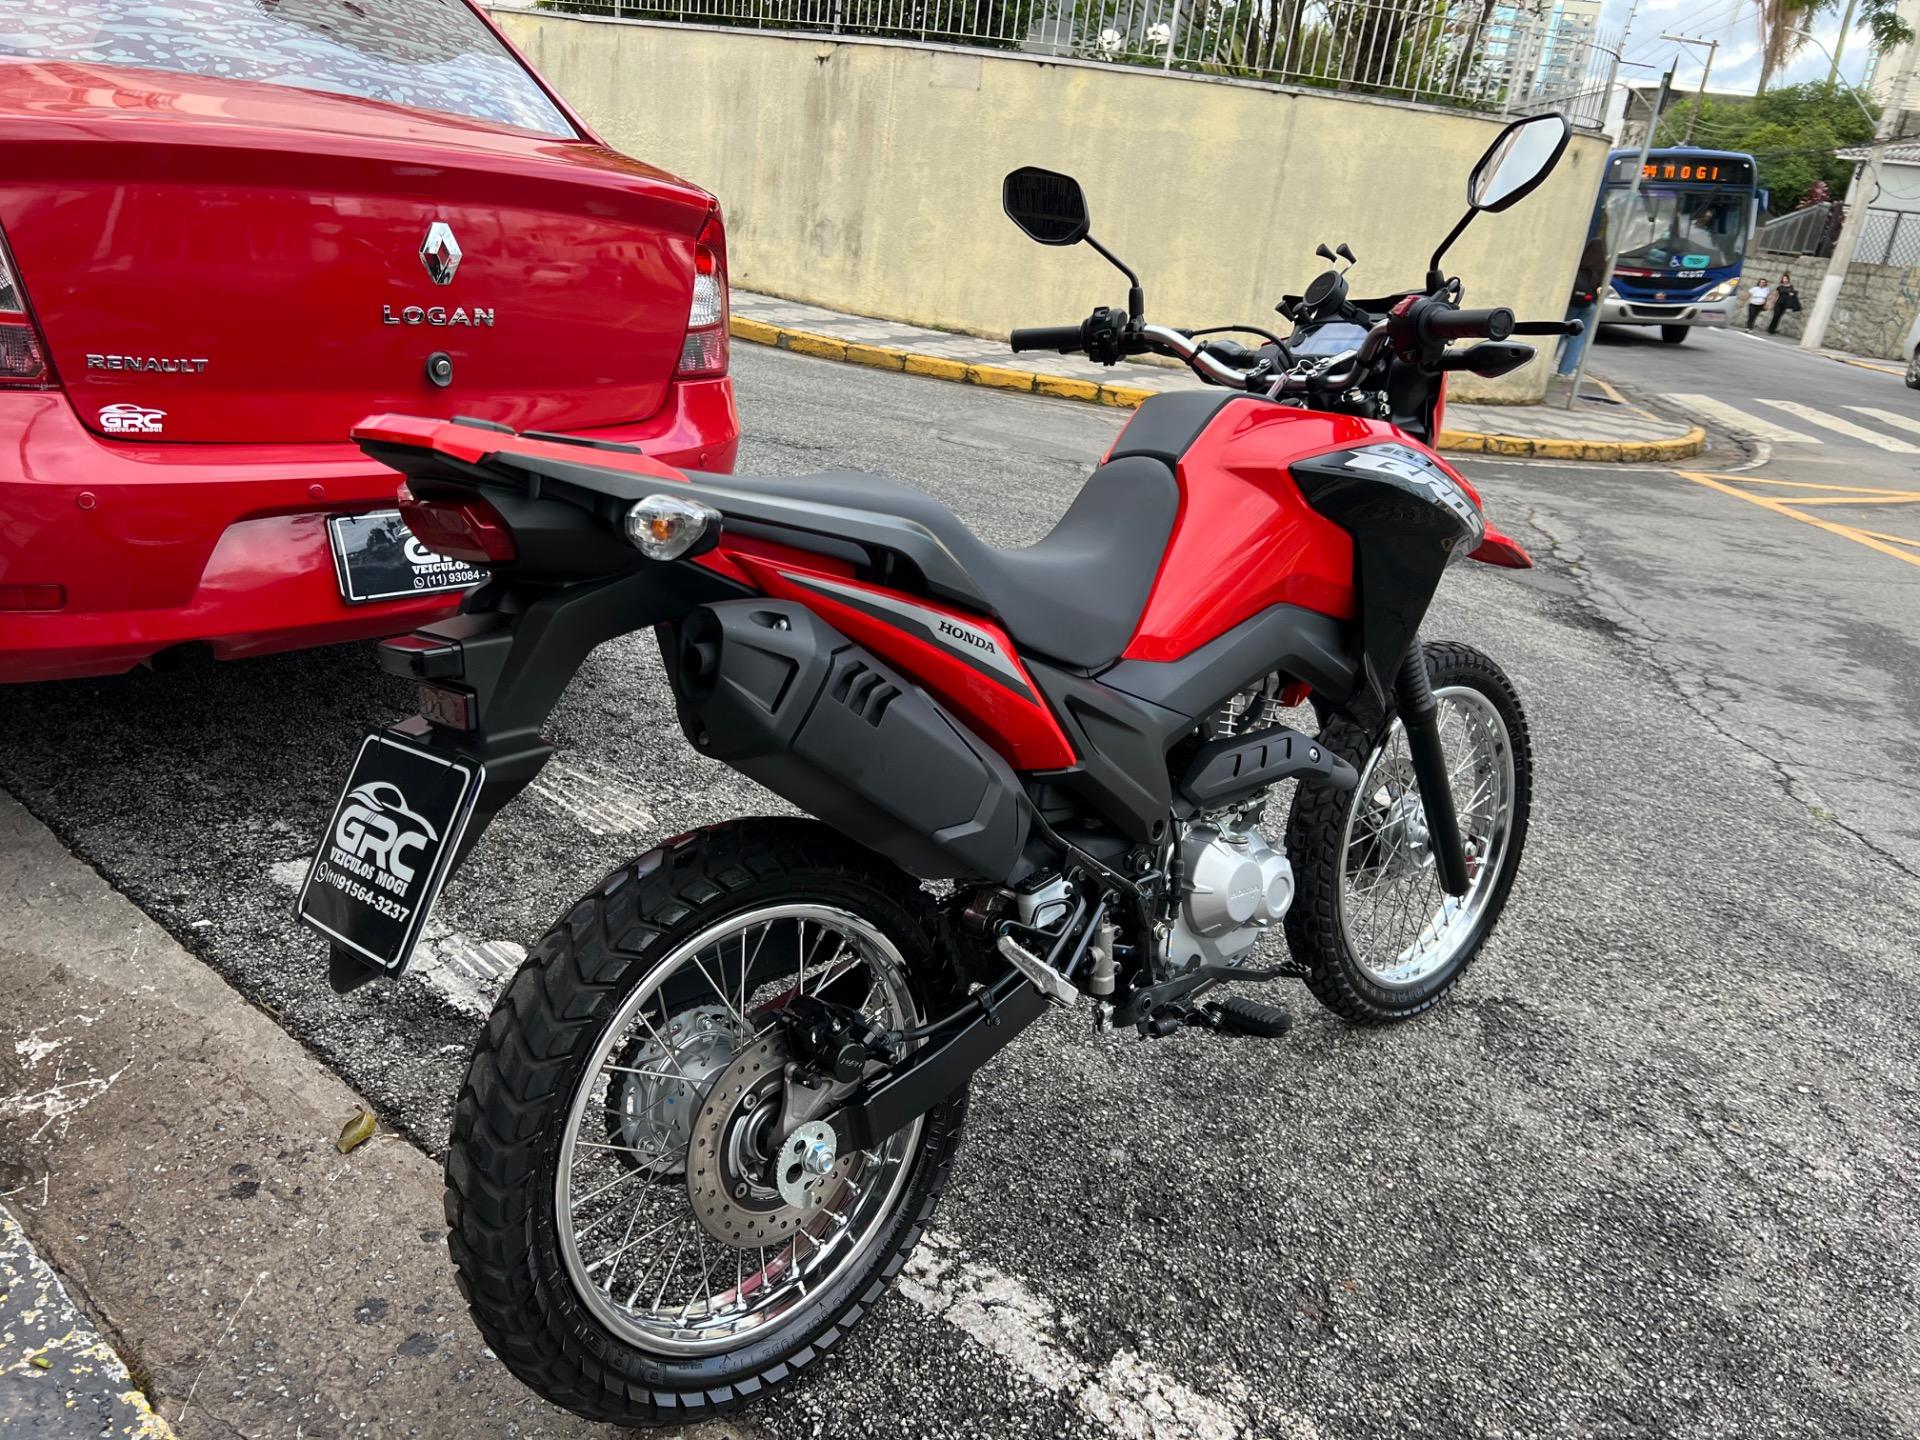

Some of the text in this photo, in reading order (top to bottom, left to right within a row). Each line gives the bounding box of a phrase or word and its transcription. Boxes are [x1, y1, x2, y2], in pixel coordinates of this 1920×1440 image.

[1664, 165, 1719, 180] MOGI
[383, 305, 495, 327] LOGAN
[86, 354, 209, 373] RENAULT
[100, 413, 163, 428] GRC
[426, 574, 447, 588] (11)
[938, 620, 997, 655] HONDA
[335, 804, 429, 884] GRC
[329, 846, 410, 898] VEICULOS MOGI
